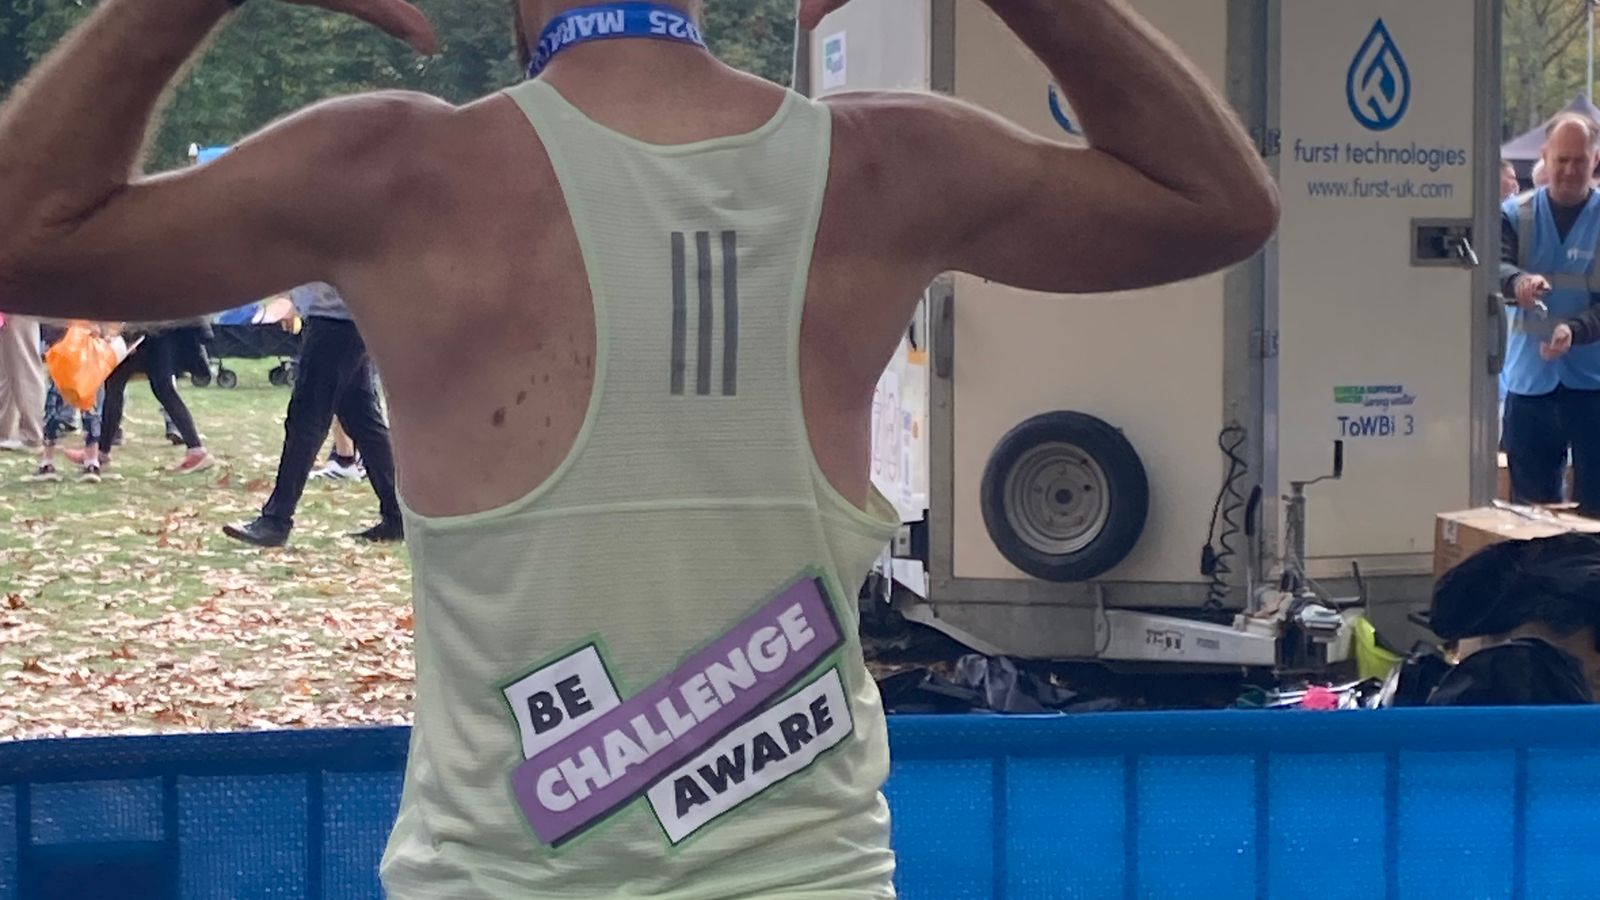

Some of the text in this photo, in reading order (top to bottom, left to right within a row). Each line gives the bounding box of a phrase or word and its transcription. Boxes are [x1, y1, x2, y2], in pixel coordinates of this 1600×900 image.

[1294, 139, 1467, 172] furst technologies
[1307, 177, 1453, 199] www.furst-uk.com
[1404, 414, 1414, 436] 3
[527, 674, 594, 735] BE
[536, 602, 816, 812] CHALLENGE
[673, 694, 834, 819] AWARE
